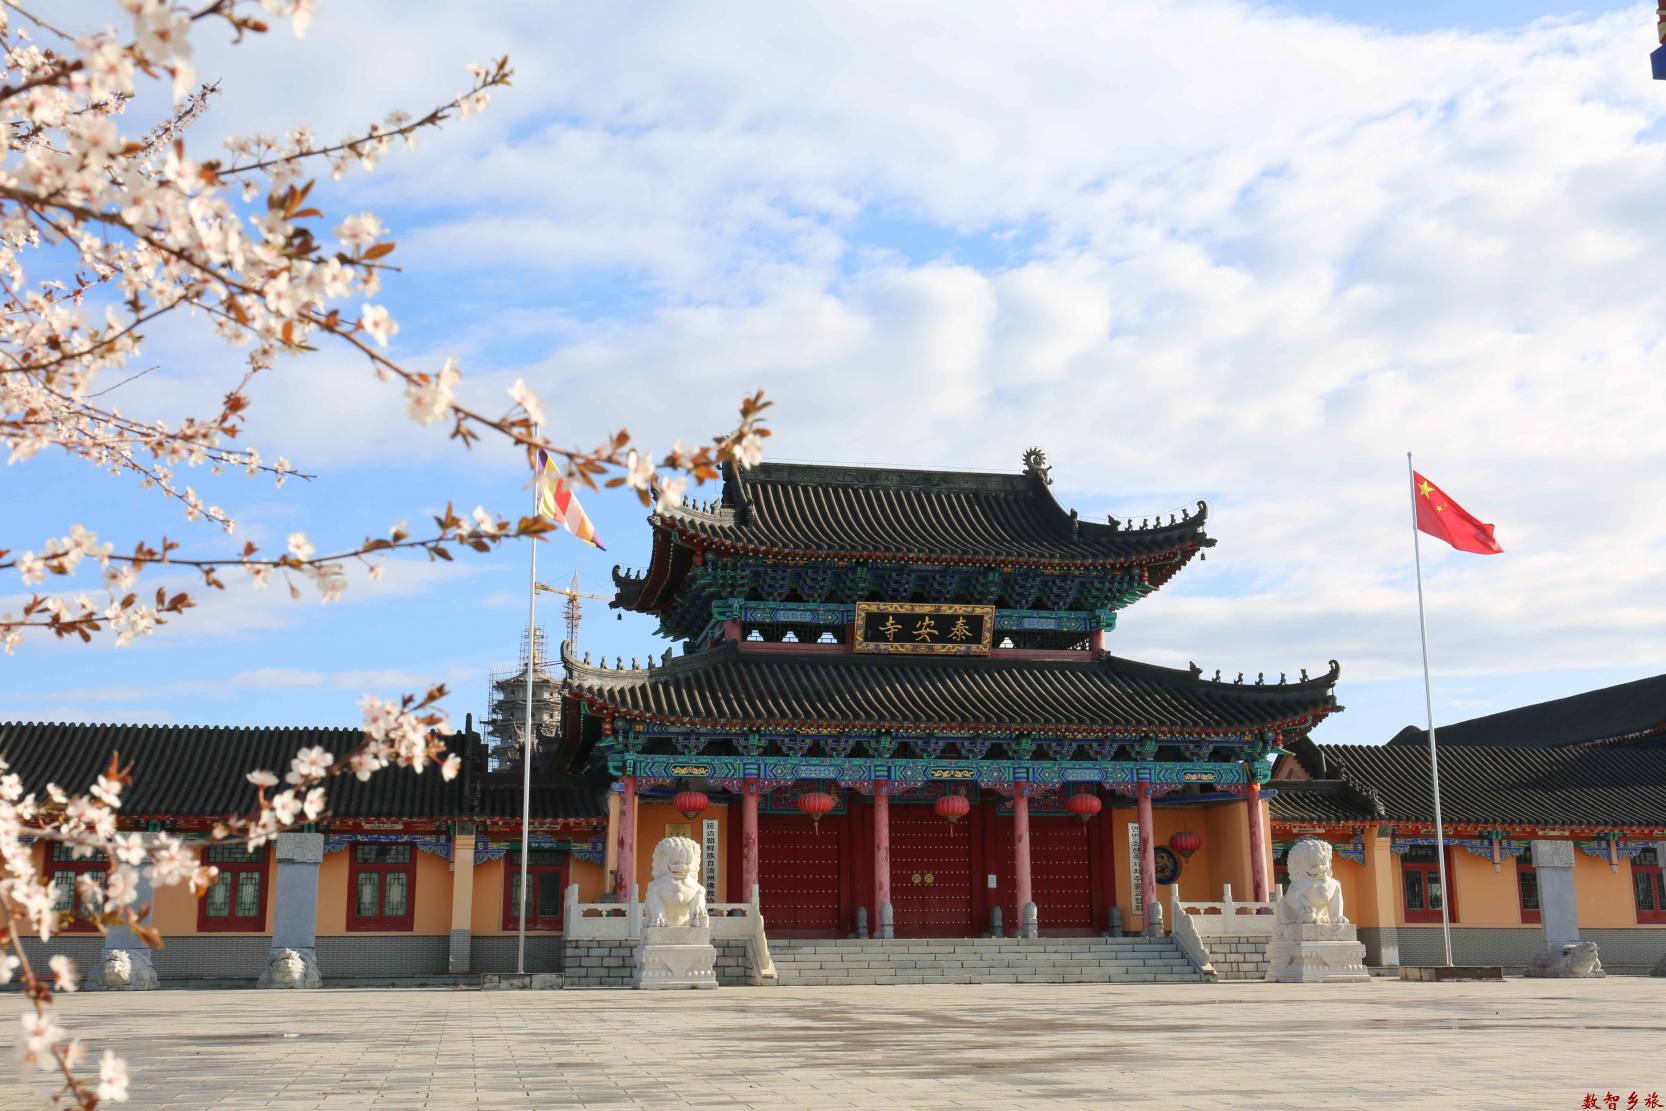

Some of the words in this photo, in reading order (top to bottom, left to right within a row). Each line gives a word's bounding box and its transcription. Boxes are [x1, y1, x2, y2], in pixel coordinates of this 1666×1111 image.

[706, 822, 715, 912] 延边朝鲜族自治州佛教协
